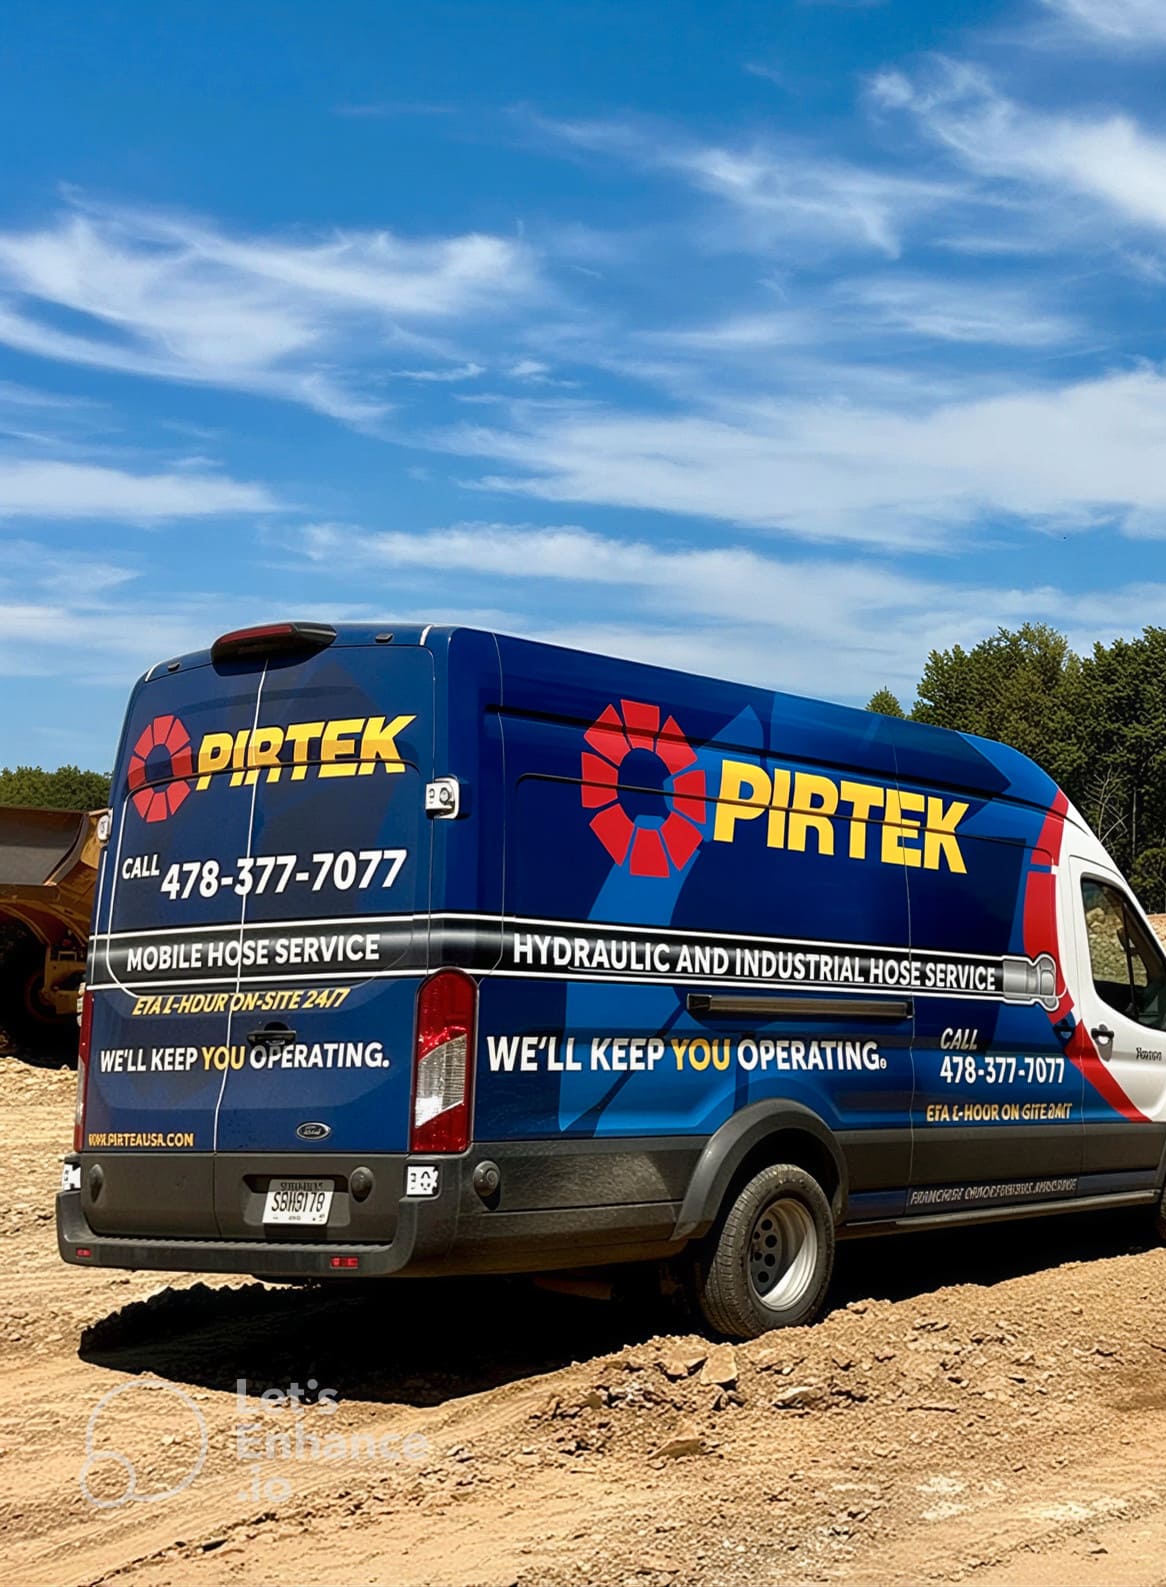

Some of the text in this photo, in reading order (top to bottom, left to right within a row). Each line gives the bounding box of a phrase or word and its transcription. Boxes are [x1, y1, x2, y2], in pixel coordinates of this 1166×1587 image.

[195, 715, 417, 791] PIRTEK
[713, 759, 969, 874] PIRTEK
[122, 849, 407, 900] CALL 478-377-7077
[126, 934, 380, 972] MOBILE HOSE SERVICE
[513, 932, 996, 990] HYDRAULIC AND INDUSTRIAL HOSE SERVICE
[132, 996, 162, 1015] ETA
[231, 990, 304, 1011] ON-SITE
[301, 987, 351, 1009] 24/7
[486, 1036, 582, 1071] WE'LL
[590, 1037, 665, 1071] KEEP
[671, 1038, 731, 1071] YOU
[940, 1028, 978, 1050] CALL
[100, 1041, 390, 1073] WE'LL KEEP YOU OPERATING.
[940, 1055, 1065, 1084] 478-377-7077
[1001, 1103, 1020, 1120] ON
